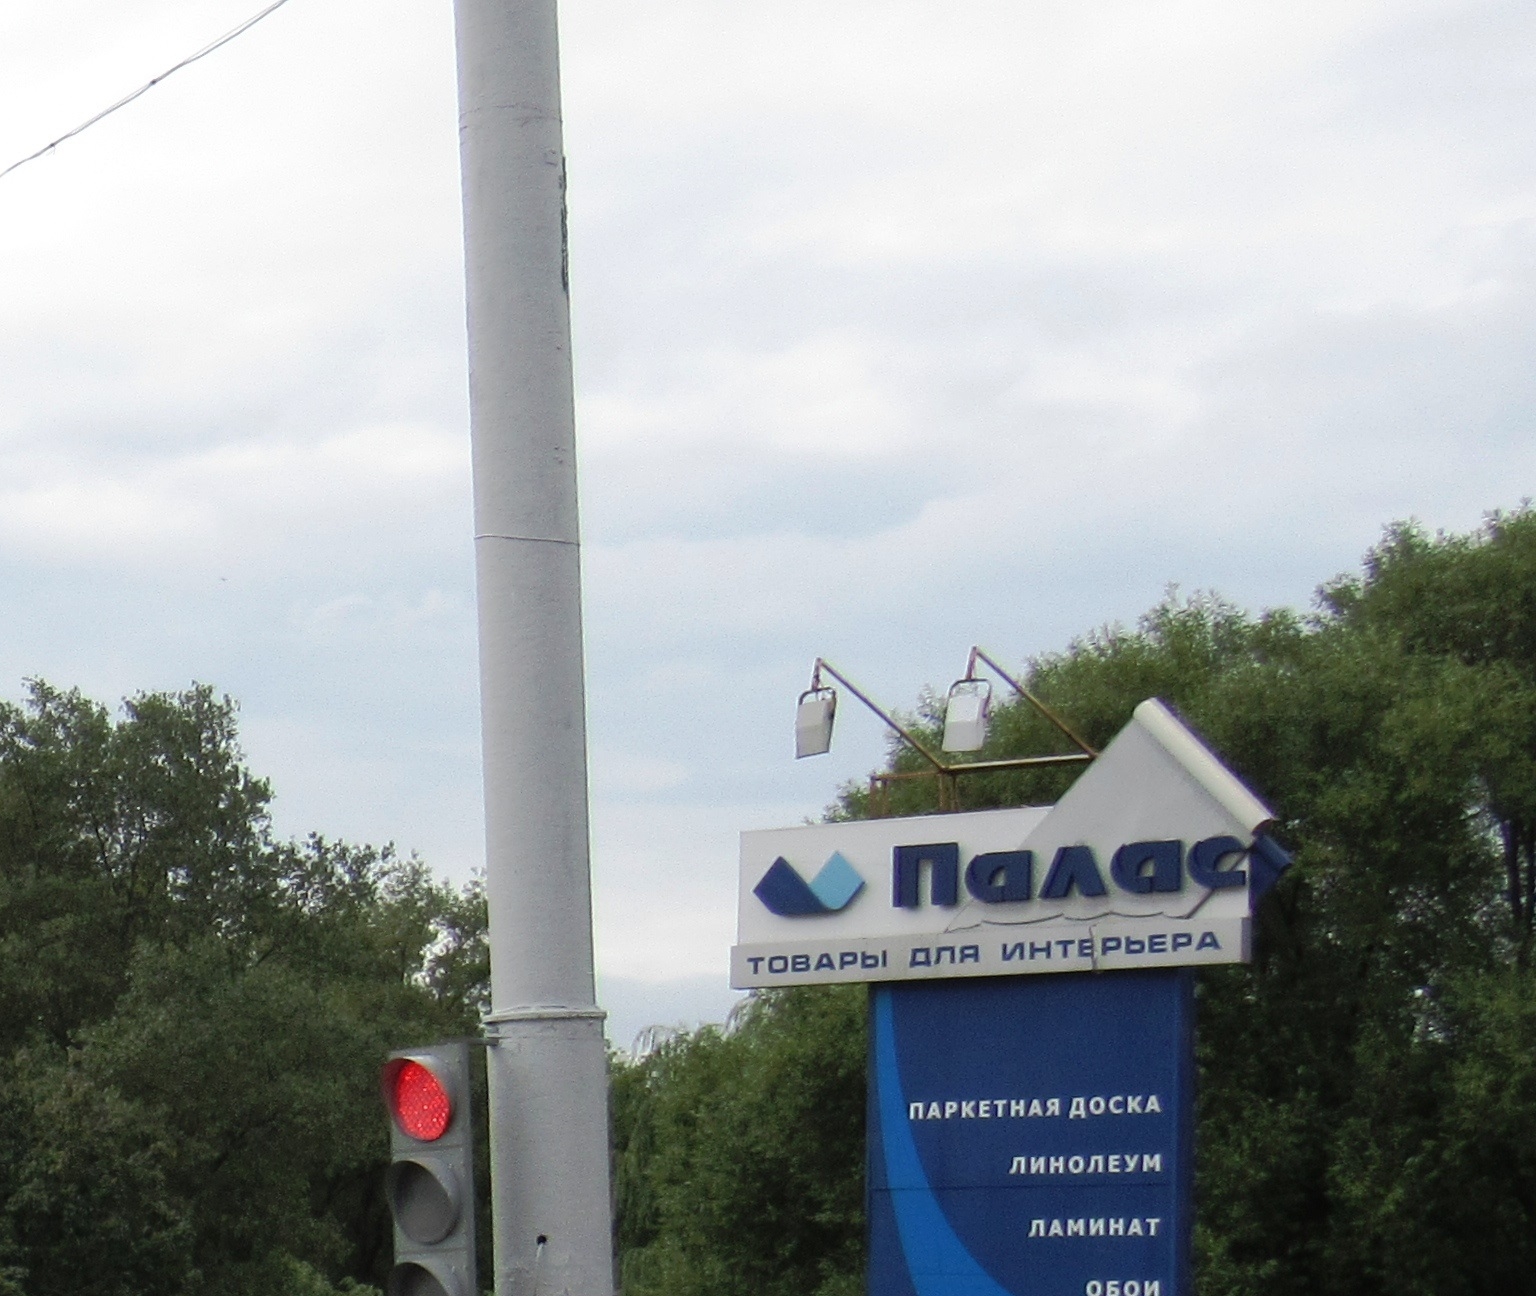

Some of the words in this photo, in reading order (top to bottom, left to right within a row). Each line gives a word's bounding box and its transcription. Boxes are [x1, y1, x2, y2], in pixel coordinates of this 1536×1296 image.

[891, 834, 1248, 908] Палас
[746, 952, 888, 975] ТОВАРЫ
[908, 944, 980, 969] ДЛЯ
[1001, 931, 1222, 962] ИНТЕРЬЕРА
[909, 1098, 1061, 1120] ПАРКЕТНАЯ
[1069, 1095, 1162, 1119] ДОСКА
[1009, 1155, 1162, 1175] ЛИНОЛЕУМ
[1028, 1218, 1161, 1239] ЛАМИНАТ
